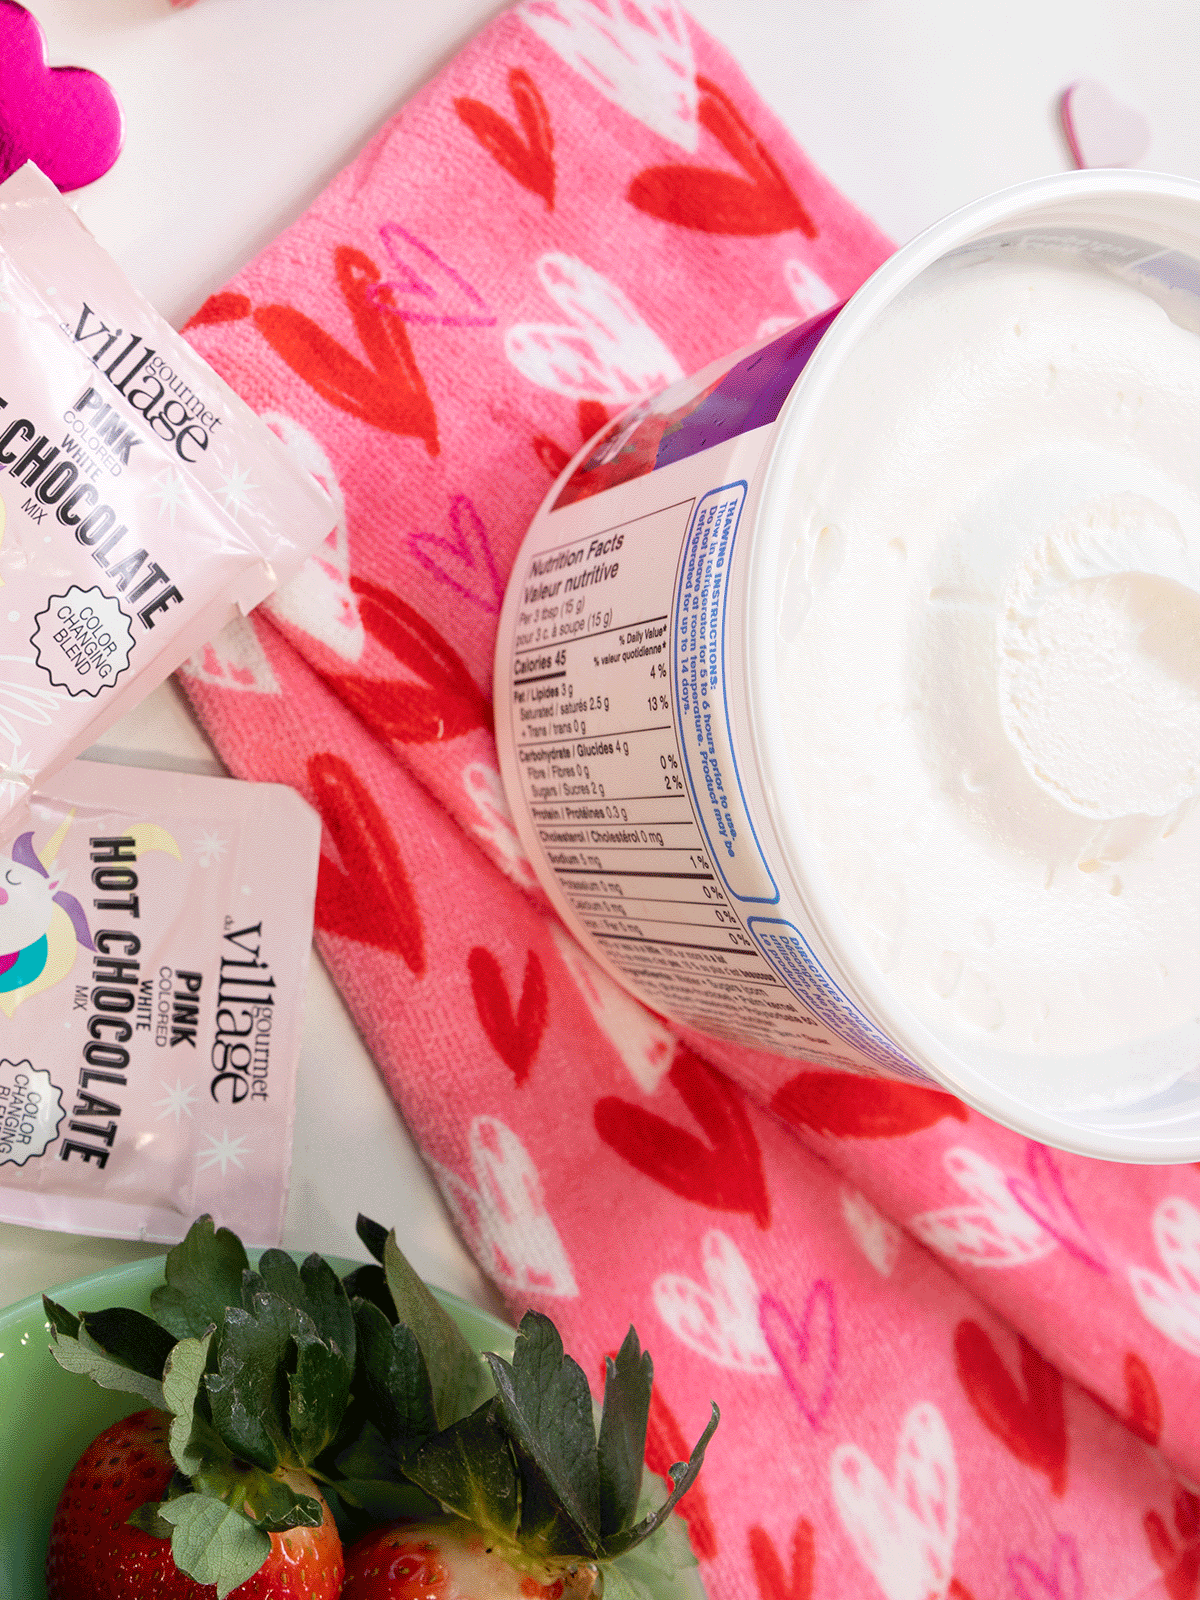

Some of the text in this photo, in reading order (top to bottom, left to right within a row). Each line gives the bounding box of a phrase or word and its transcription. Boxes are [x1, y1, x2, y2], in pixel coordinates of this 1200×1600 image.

[74, 302, 209, 463] village
[145, 356, 222, 434] gourmet
[63, 410, 122, 477] COLORED
[72, 387, 141, 466] PINK
[61, 433, 102, 483] WHITE
[21, 497, 48, 525] MIX
[706, 505, 718, 524] Do
[529, 534, 625, 578] Nutrition Facts
[701, 528, 710, 550] not
[524, 562, 619, 604] Valeur nutritive
[694, 553, 706, 592] leave
[680, 509, 707, 715] refrigerated for up to 14 days.
[692, 596, 699, 610] at
[709, 499, 737, 690] THAWING INSTRUCTIONS:
[78, 606, 117, 657] COLOR
[587, 611, 602, 632] (15
[603, 607, 611, 628] g)
[627, 631, 642, 644] Daily
[52, 628, 91, 675] BLEND
[57, 606, 112, 679] CHANGING
[514, 649, 566, 676] Calories 45
[601, 653, 621, 665] valeur
[650, 663, 667, 679] 4 %
[699, 502, 737, 841] Thaw in refrigerator for 5 to 6 hours prior to use.
[520, 695, 609, 721] Saturated saturés 2.5 g
[531, 684, 573, 702] Lipides g
[647, 695, 669, 711] 13 %
[689, 655, 704, 746] temperature.
[519, 740, 629, 763] Carbohydrate Glucides 4 g
[660, 754, 678, 770] 0 %
[664, 775, 683, 790] 2 %
[699, 751, 719, 805] Product
[565, 805, 628, 822] Protéines 0.3 g
[713, 808, 728, 837] may
[590, 830, 664, 847] Cholestérol mg
[724, 841, 735, 857] be
[690, 855, 709, 869] 1 %
[789, 937, 843, 1002] DIRECTIVES
[59, 836, 141, 1170] HOT CHOCOLATE
[73, 985, 89, 1011] MIX
[136, 978, 153, 1031] WHITE
[155, 966, 173, 1048] COLORED
[170, 971, 203, 1048] PINK
[210, 922, 276, 1104] village
[250, 1005, 273, 1101] gourmet
[15, 1092, 39, 1145] COLOR
